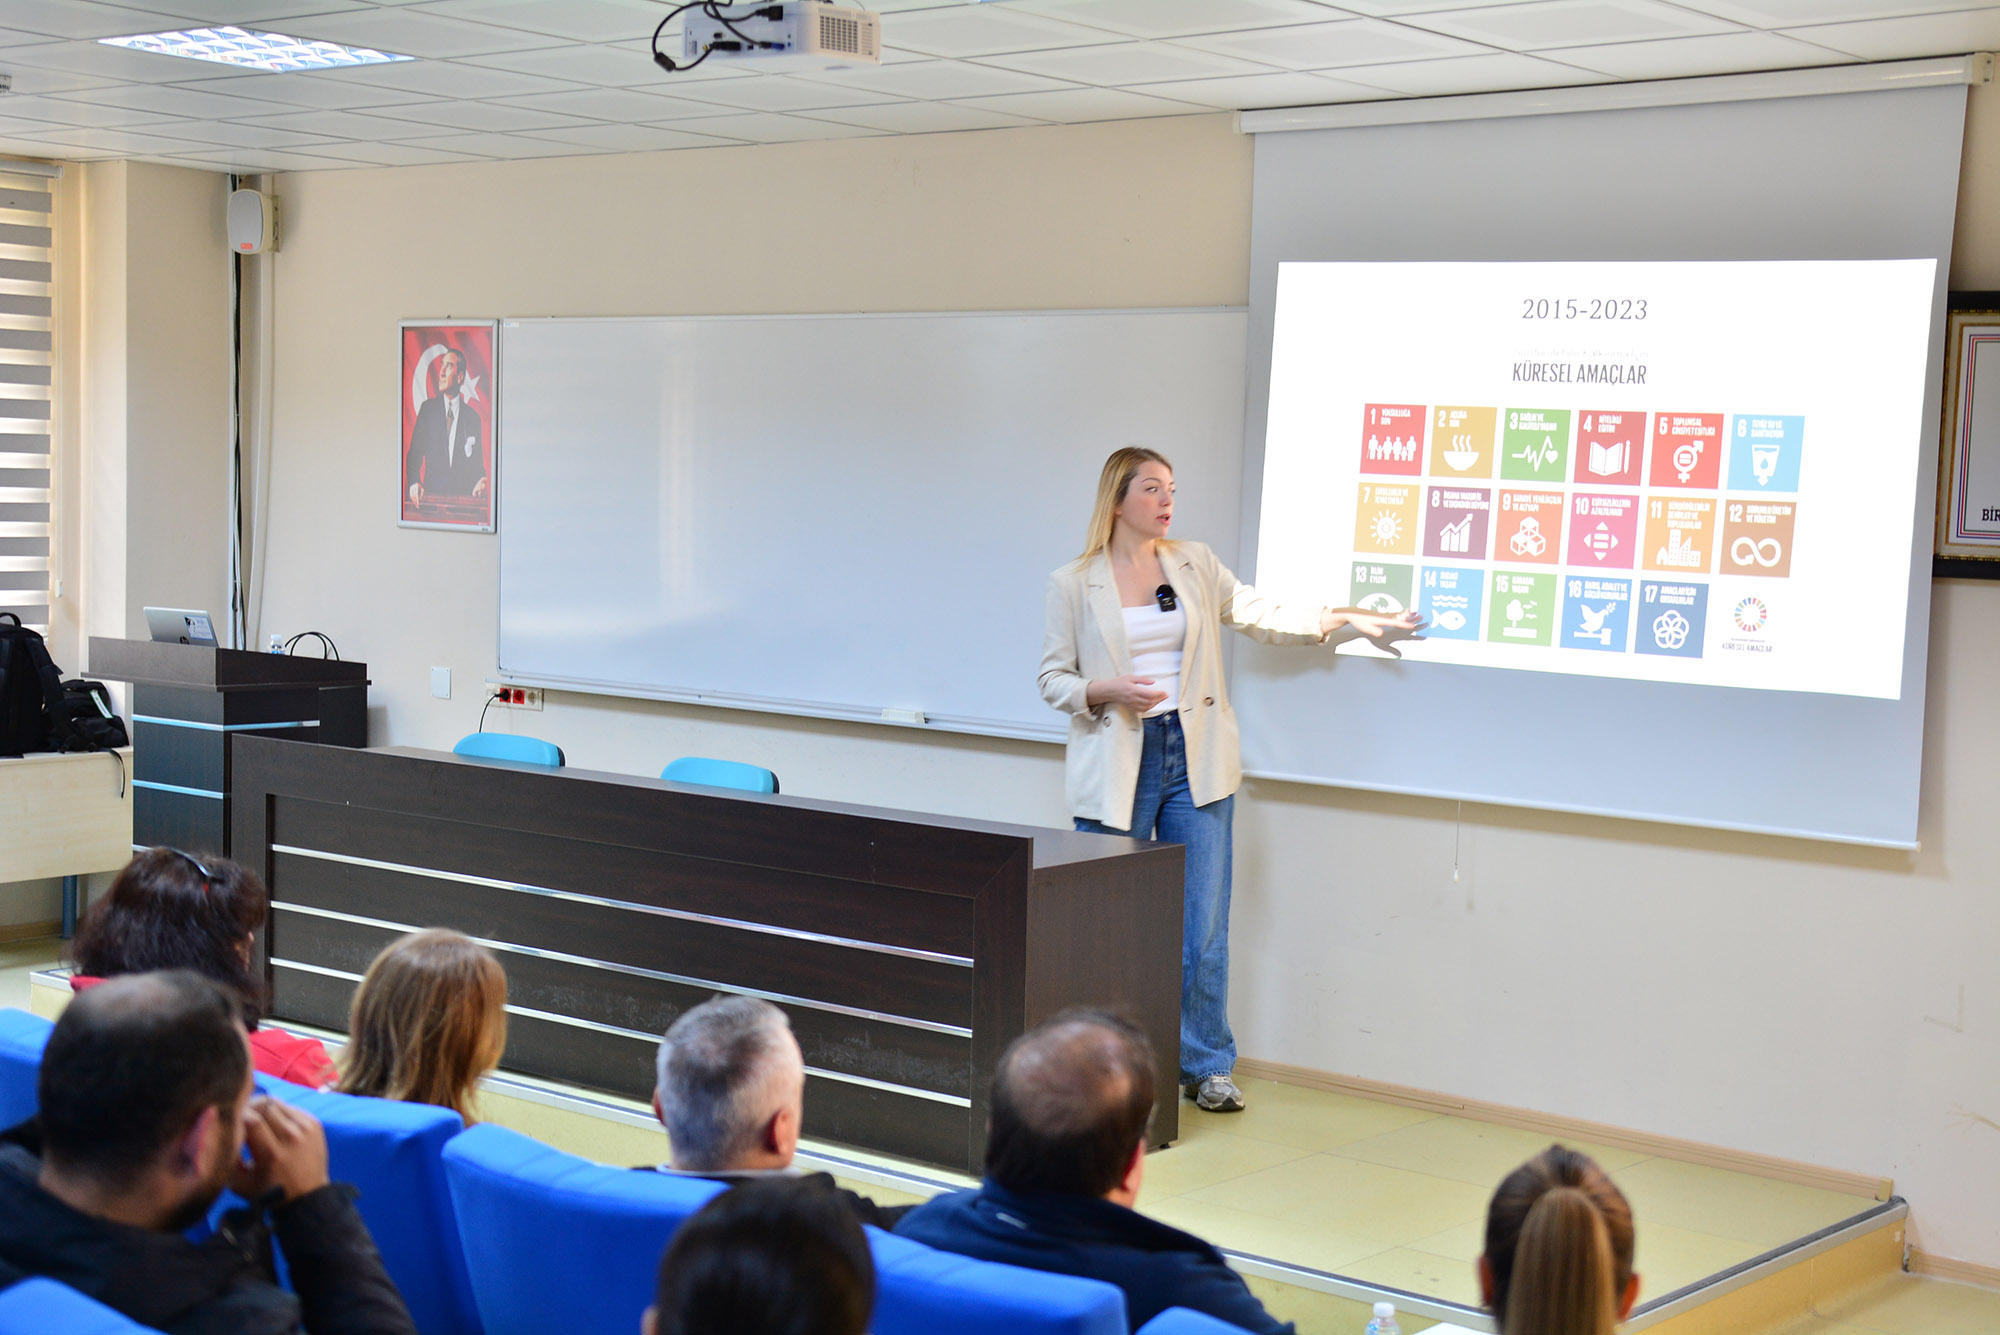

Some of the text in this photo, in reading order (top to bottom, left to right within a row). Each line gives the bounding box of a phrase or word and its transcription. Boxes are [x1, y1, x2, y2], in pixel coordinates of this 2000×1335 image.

[1522, 299, 1648, 320] 2015-2023
[1512, 360, 1647, 386] KÜRESEL AMAÇLAR
[1371, 408, 1376, 424] 1
[1438, 410, 1446, 427] 2
[1510, 412, 1518, 430] 3
[1584, 415, 1592, 432] 4
[1660, 417, 1668, 434] 5
[1738, 419, 1747, 437] 6
[1364, 487, 1370, 502] 7
[1432, 490, 1440, 507] 8
[1503, 494, 1511, 510] 9
[1575, 497, 1589, 515] 10
[1651, 501, 1662, 518] 11
[1730, 504, 1743, 522] 12
[1982, 506, 2000, 522] BİR
[1356, 566, 1367, 583] 13
[1424, 571, 1436, 587] 14
[1496, 575, 1508, 592] 15
[1569, 580, 1582, 598] 16
[1645, 585, 1657, 603] 17
